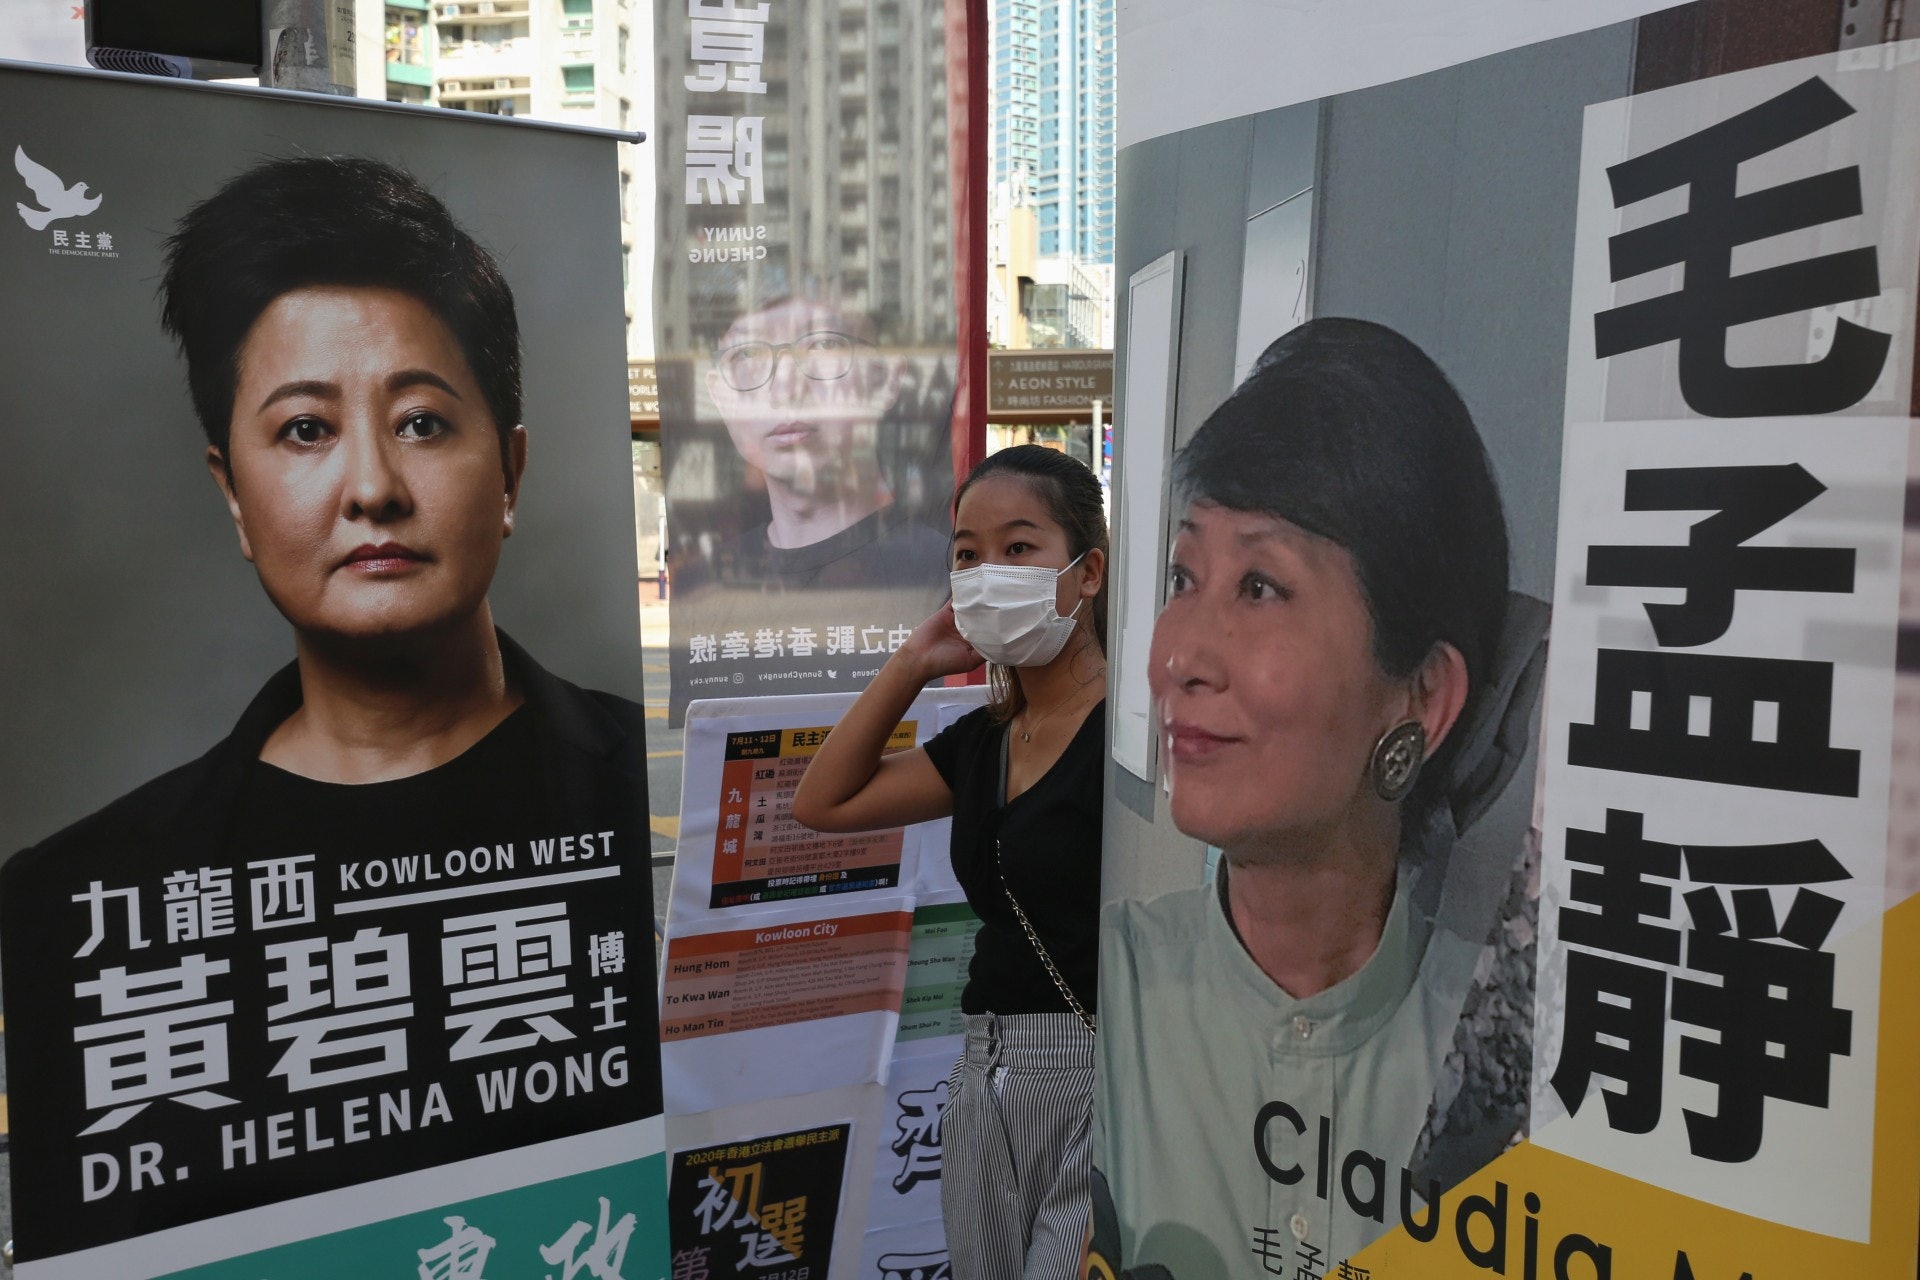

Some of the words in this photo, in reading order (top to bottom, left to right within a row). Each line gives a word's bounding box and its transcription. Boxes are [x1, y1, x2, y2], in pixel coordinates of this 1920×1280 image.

[53, 229, 113, 251] 民主黨
[61, 249, 101, 257] DEMOCRATIC
[101, 251, 120, 259] PARTY
[1008, 378, 1051, 390] AEON
[1055, 376, 1096, 389] STYLE
[1550, 75, 1892, 1164] 毛孟靜
[722, 788, 743, 855] 九龍城
[71, 854, 317, 958] 九龍西
[340, 843, 516, 892] KOWLOON
[529, 830, 616, 866] WEST
[674, 960, 702, 974] Hung
[704, 959, 730, 970] Hom
[755, 926, 811, 944] Kowloon
[813, 922, 838, 939] City
[588, 931, 628, 1034] 博士
[666, 995, 680, 1004] To
[682, 993, 701, 1004] Kwa
[704, 988, 731, 1001] Wan
[73, 901, 578, 1137] 黃碧雲
[665, 1025, 679, 1035] Ho
[682, 1022, 705, 1033] Man
[708, 1018, 724, 1029] Tin
[81, 1141, 190, 1203] DR.
[221, 1083, 454, 1171] HELENA
[476, 1046, 630, 1114] WONG
[693, 1162, 808, 1272] 初選
[1252, 1099, 1613, 1280] Claudia
